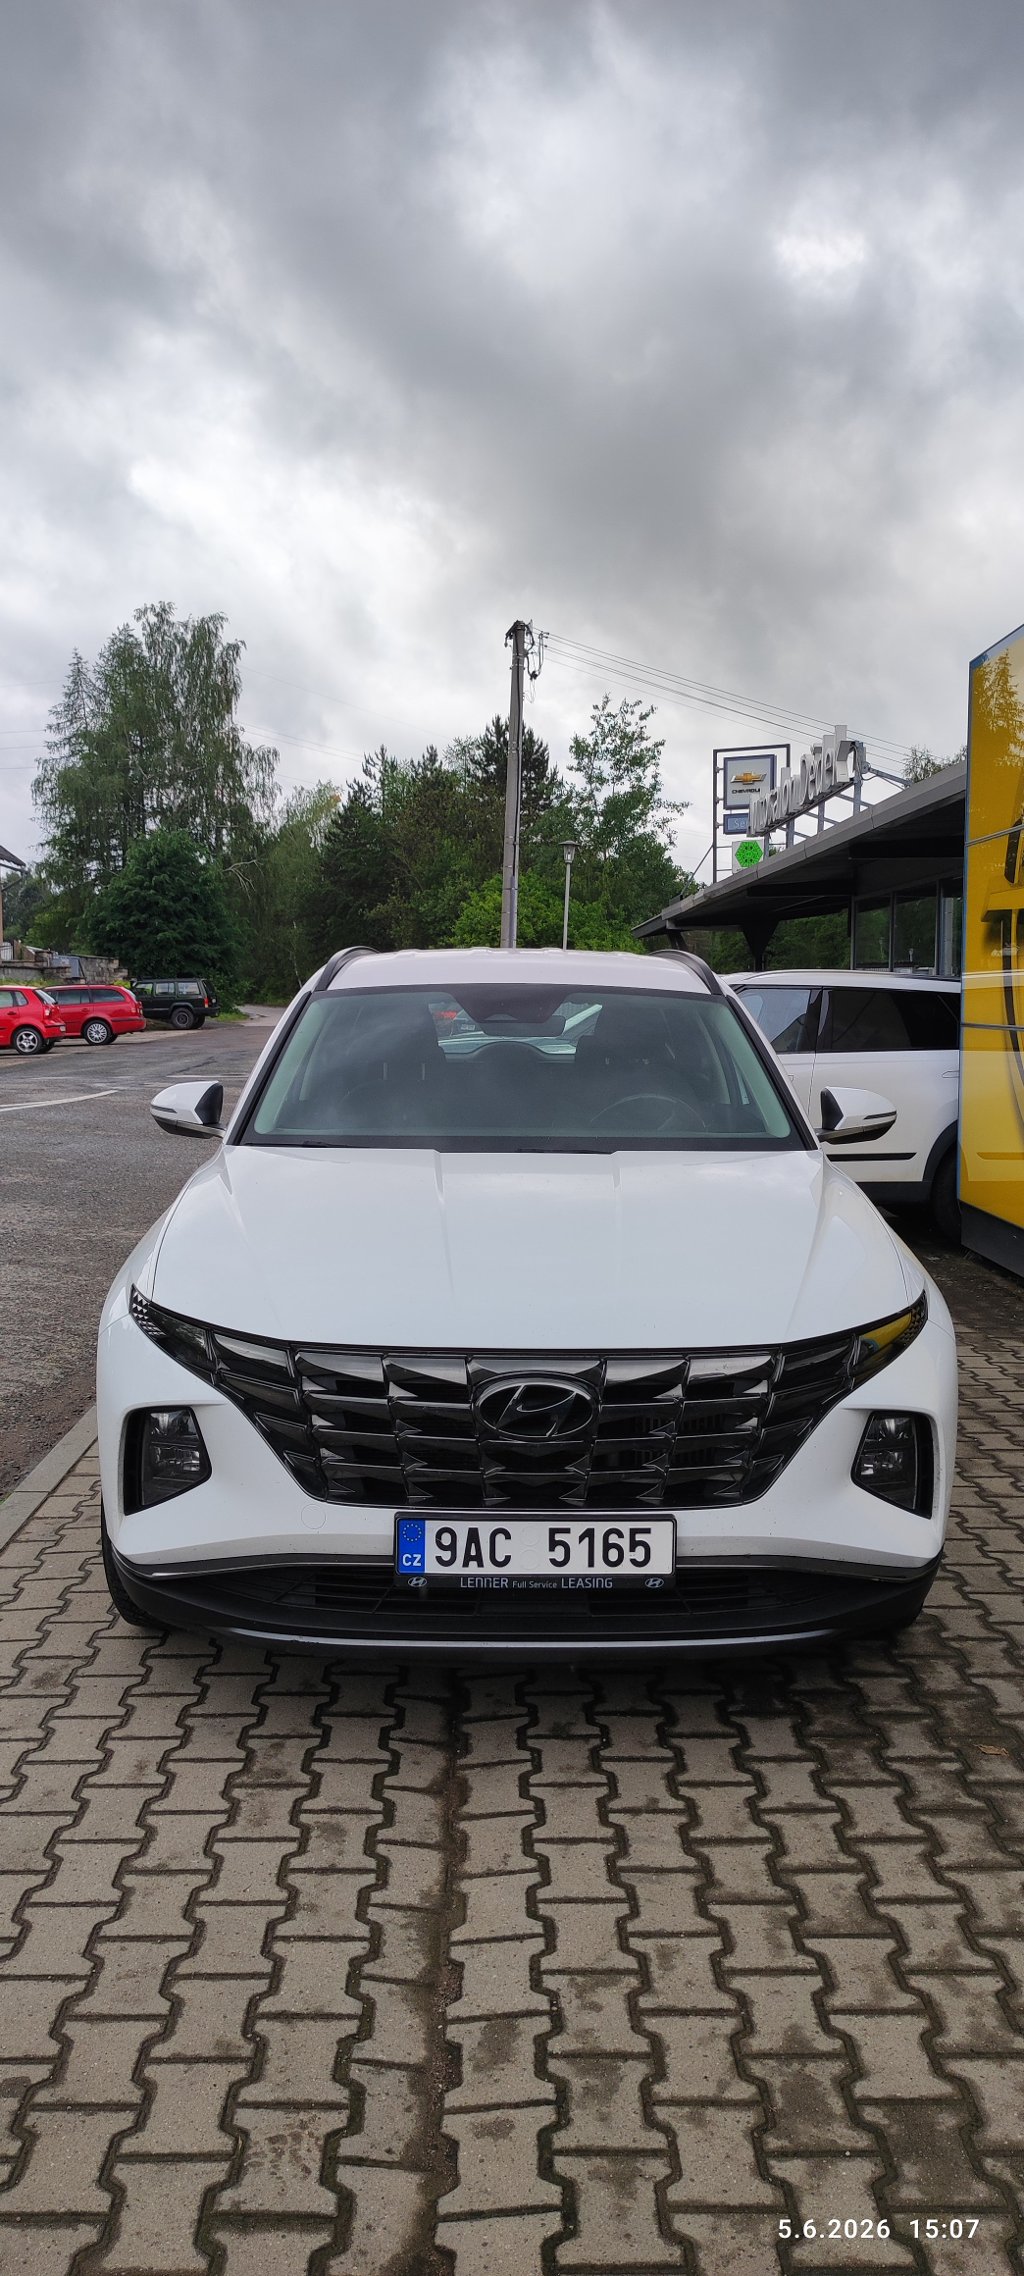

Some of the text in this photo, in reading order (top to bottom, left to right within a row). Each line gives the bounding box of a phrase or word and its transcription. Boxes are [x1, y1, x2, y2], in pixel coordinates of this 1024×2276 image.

[435, 1527, 652, 1568] 9AC 5165
[402, 1554, 422, 1567] CZ
[512, 1580, 527, 1589] Full
[529, 1580, 558, 1589] Service
[561, 1578, 613, 1589] LEASING
